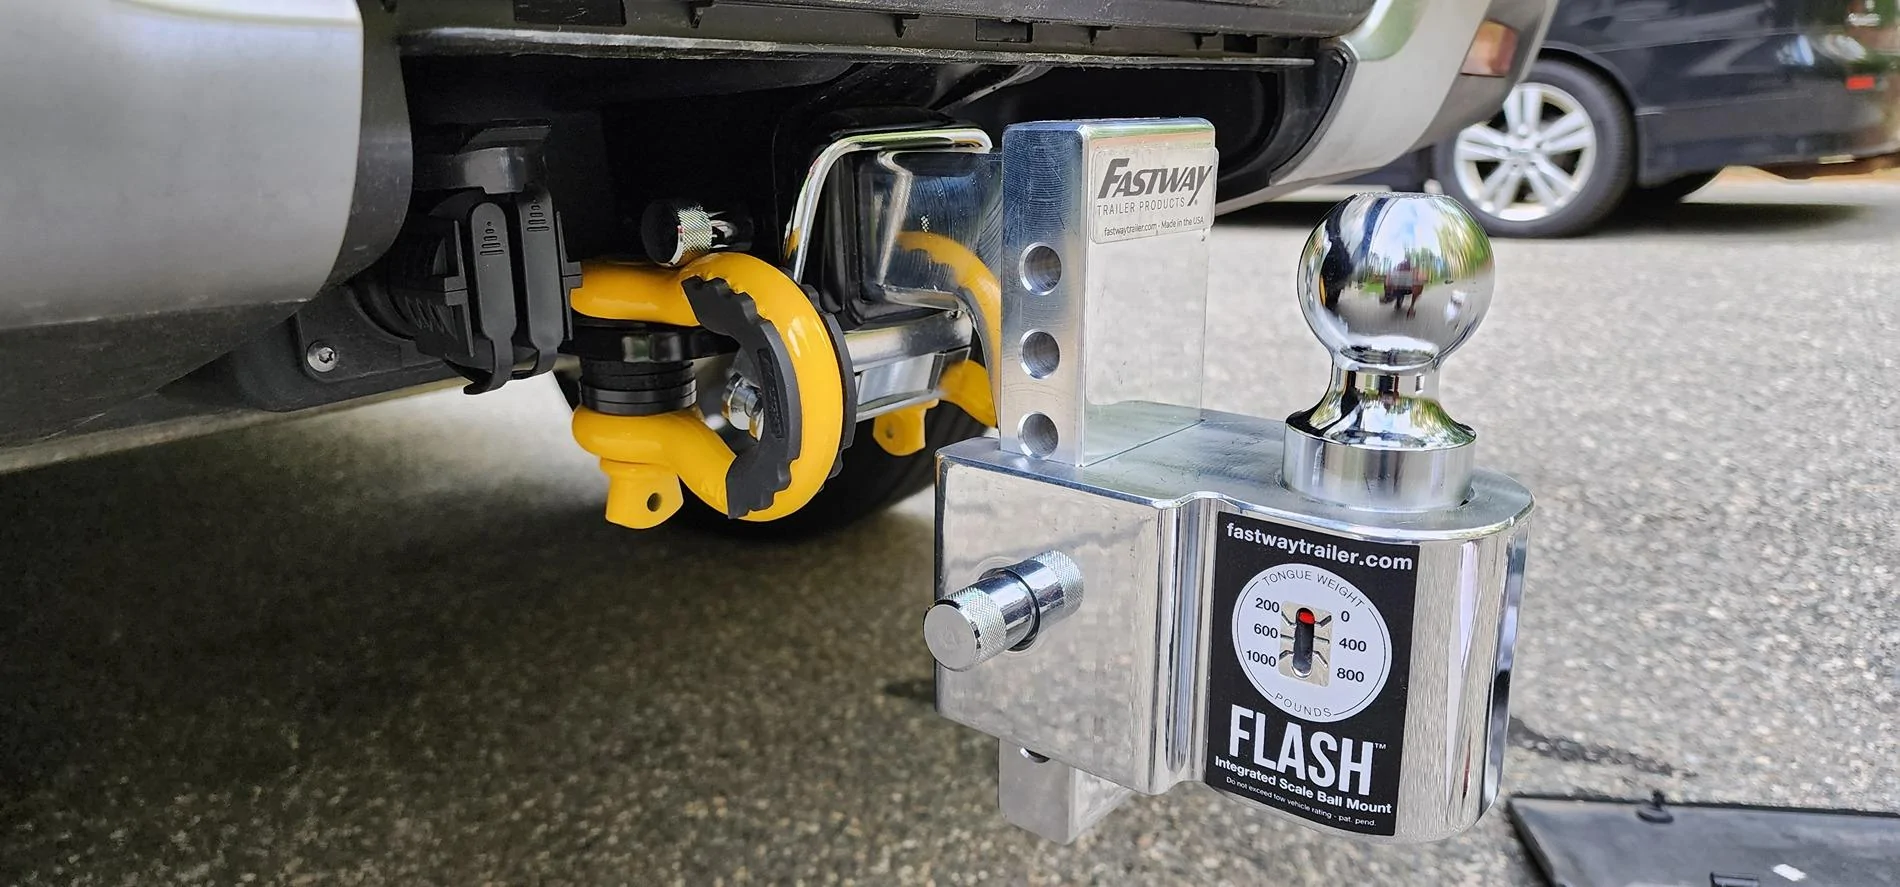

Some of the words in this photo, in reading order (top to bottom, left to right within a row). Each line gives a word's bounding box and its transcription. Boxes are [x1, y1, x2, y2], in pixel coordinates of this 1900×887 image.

[1097, 157, 1213, 207] FASTWAY
[1097, 202, 1135, 217] TRAILER
[1140, 197, 1185, 212] PRODUCTS
[1104, 222, 1157, 237] fastwaytrailer.com
[1161, 218, 1177, 230] Made
[1177, 217, 1183, 227] in
[1183, 216, 1192, 226] the
[1192, 215, 1205, 225] USA
[1226, 522, 1413, 570] fastwaytrailer.com
[1262, 569, 1312, 587] TONGUE
[1316, 573, 1365, 608] WEIGHT
[1255, 597, 1280, 613] 200
[1340, 610, 1350, 622] 0
[1253, 623, 1278, 639] 600
[1338, 637, 1367, 652] 400
[1246, 650, 1277, 667] 1000
[1336, 667, 1365, 683] 800
[1274, 692, 1332, 718] POUNDS
[1229, 704, 1374, 796] FLASH
[1215, 755, 1276, 786] Integrated
[1279, 775, 1314, 799] Scale
[1317, 790, 1342, 808] Ball
[1346, 797, 1392, 814] Mount
[1226, 776, 1235, 786] Do
[1236, 780, 1248, 790] not
[1248, 785, 1273, 799] exceed
[1273, 793, 1286, 803] tow
[1287, 797, 1311, 812] vehicle
[1311, 806, 1332, 820] rating
[1338, 814, 1353, 827] pat.
[1355, 817, 1377, 827] pend.
